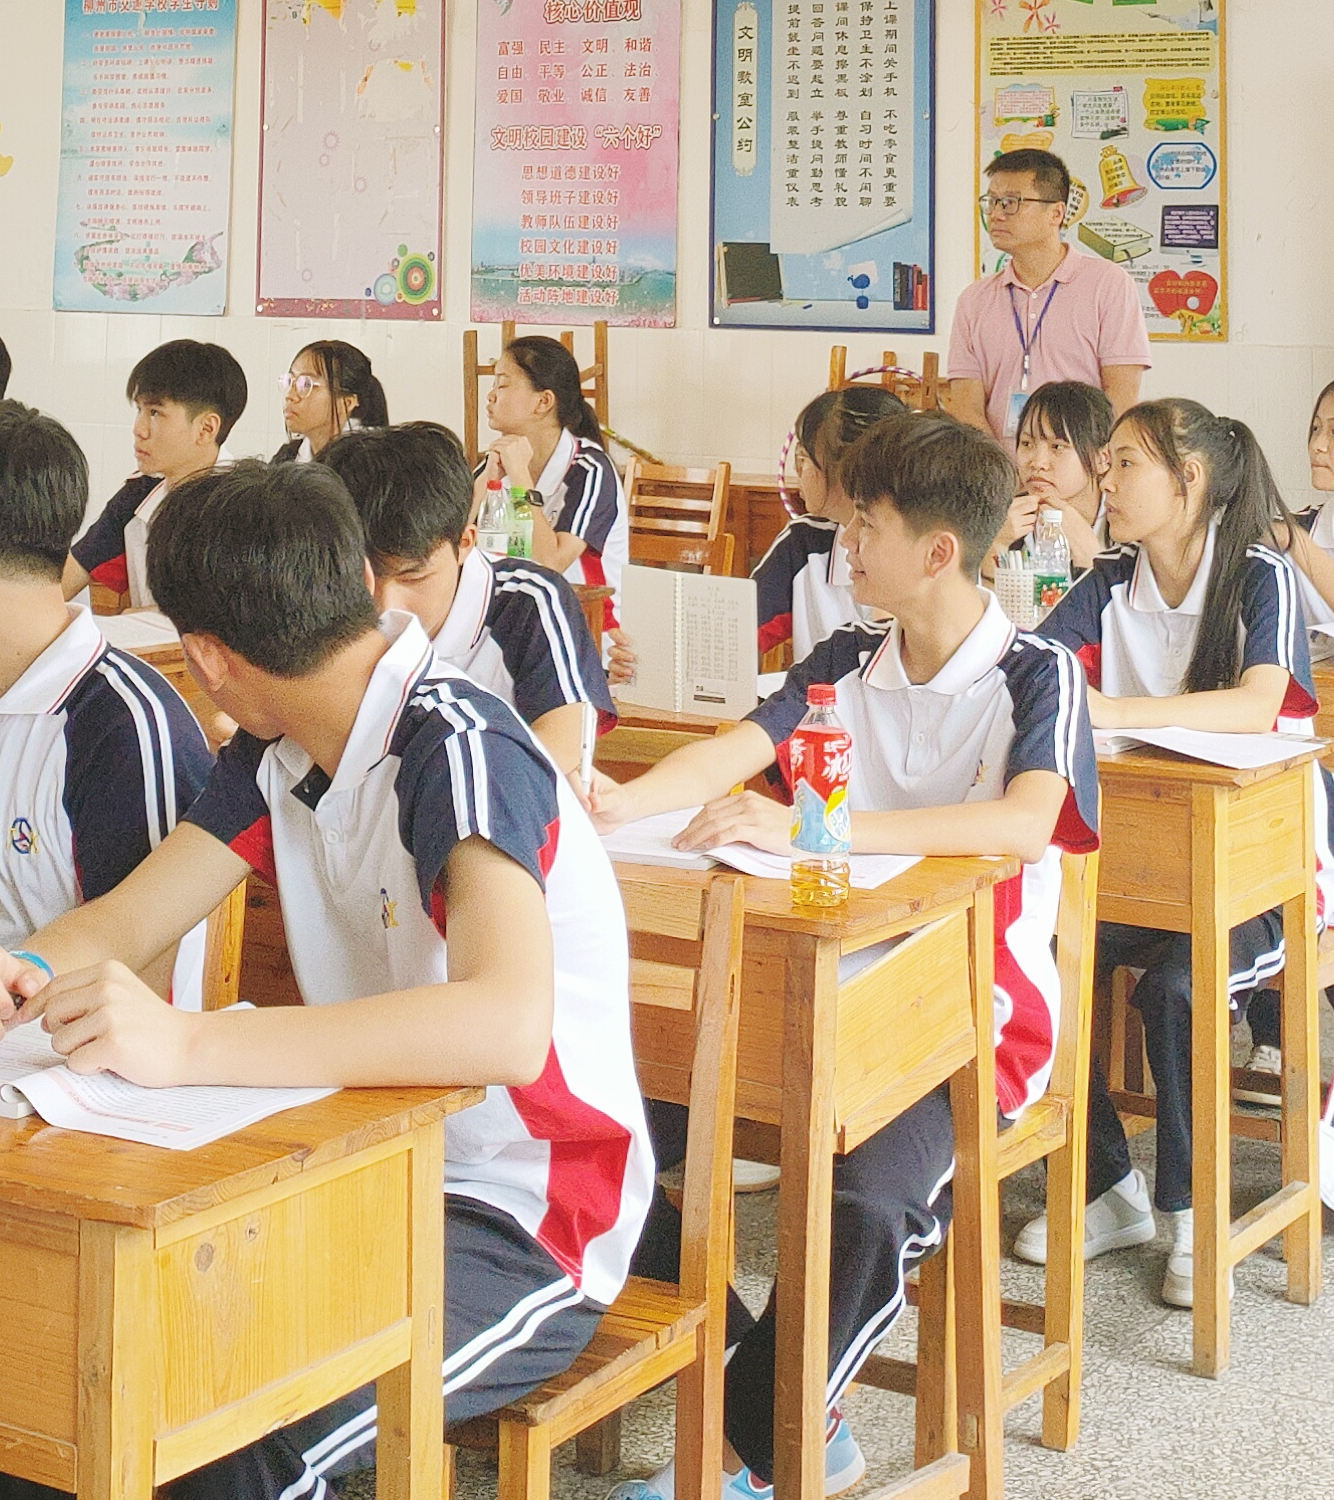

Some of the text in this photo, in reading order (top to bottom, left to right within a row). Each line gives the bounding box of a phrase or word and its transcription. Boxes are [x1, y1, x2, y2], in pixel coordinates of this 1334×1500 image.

[736, 26, 754, 153] 文明教室公约
[786, 4, 800, 99] 提前就坐不迟到
[810, 3, 825, 98] 回答问题要起立
[835, 2, 849, 98] 课间休息擦黑板
[858, 1, 874, 97] 保持卫生不涂划
[883, 1, 898, 97] 上课期间关手机
[521, 165, 620, 181] 思想道德建设好
[521, 190, 620, 205] 领导班子建设好
[785, 111, 800, 208] 服装整洁重仪表
[810, 111, 824, 207] 举手提问勤思考
[834, 110, 848, 207] 尊重教师懂礼貌
[858, 110, 873, 207] 自习时间不闲聊
[883, 109, 898, 207] 不吃零食更重要
[519, 238, 619, 255] 校园文化建设好
[520, 214, 619, 230] 教师队伍建设好
[518, 263, 618, 280] 优美环境建设好
[518, 288, 618, 305] 活动阵地建设好
